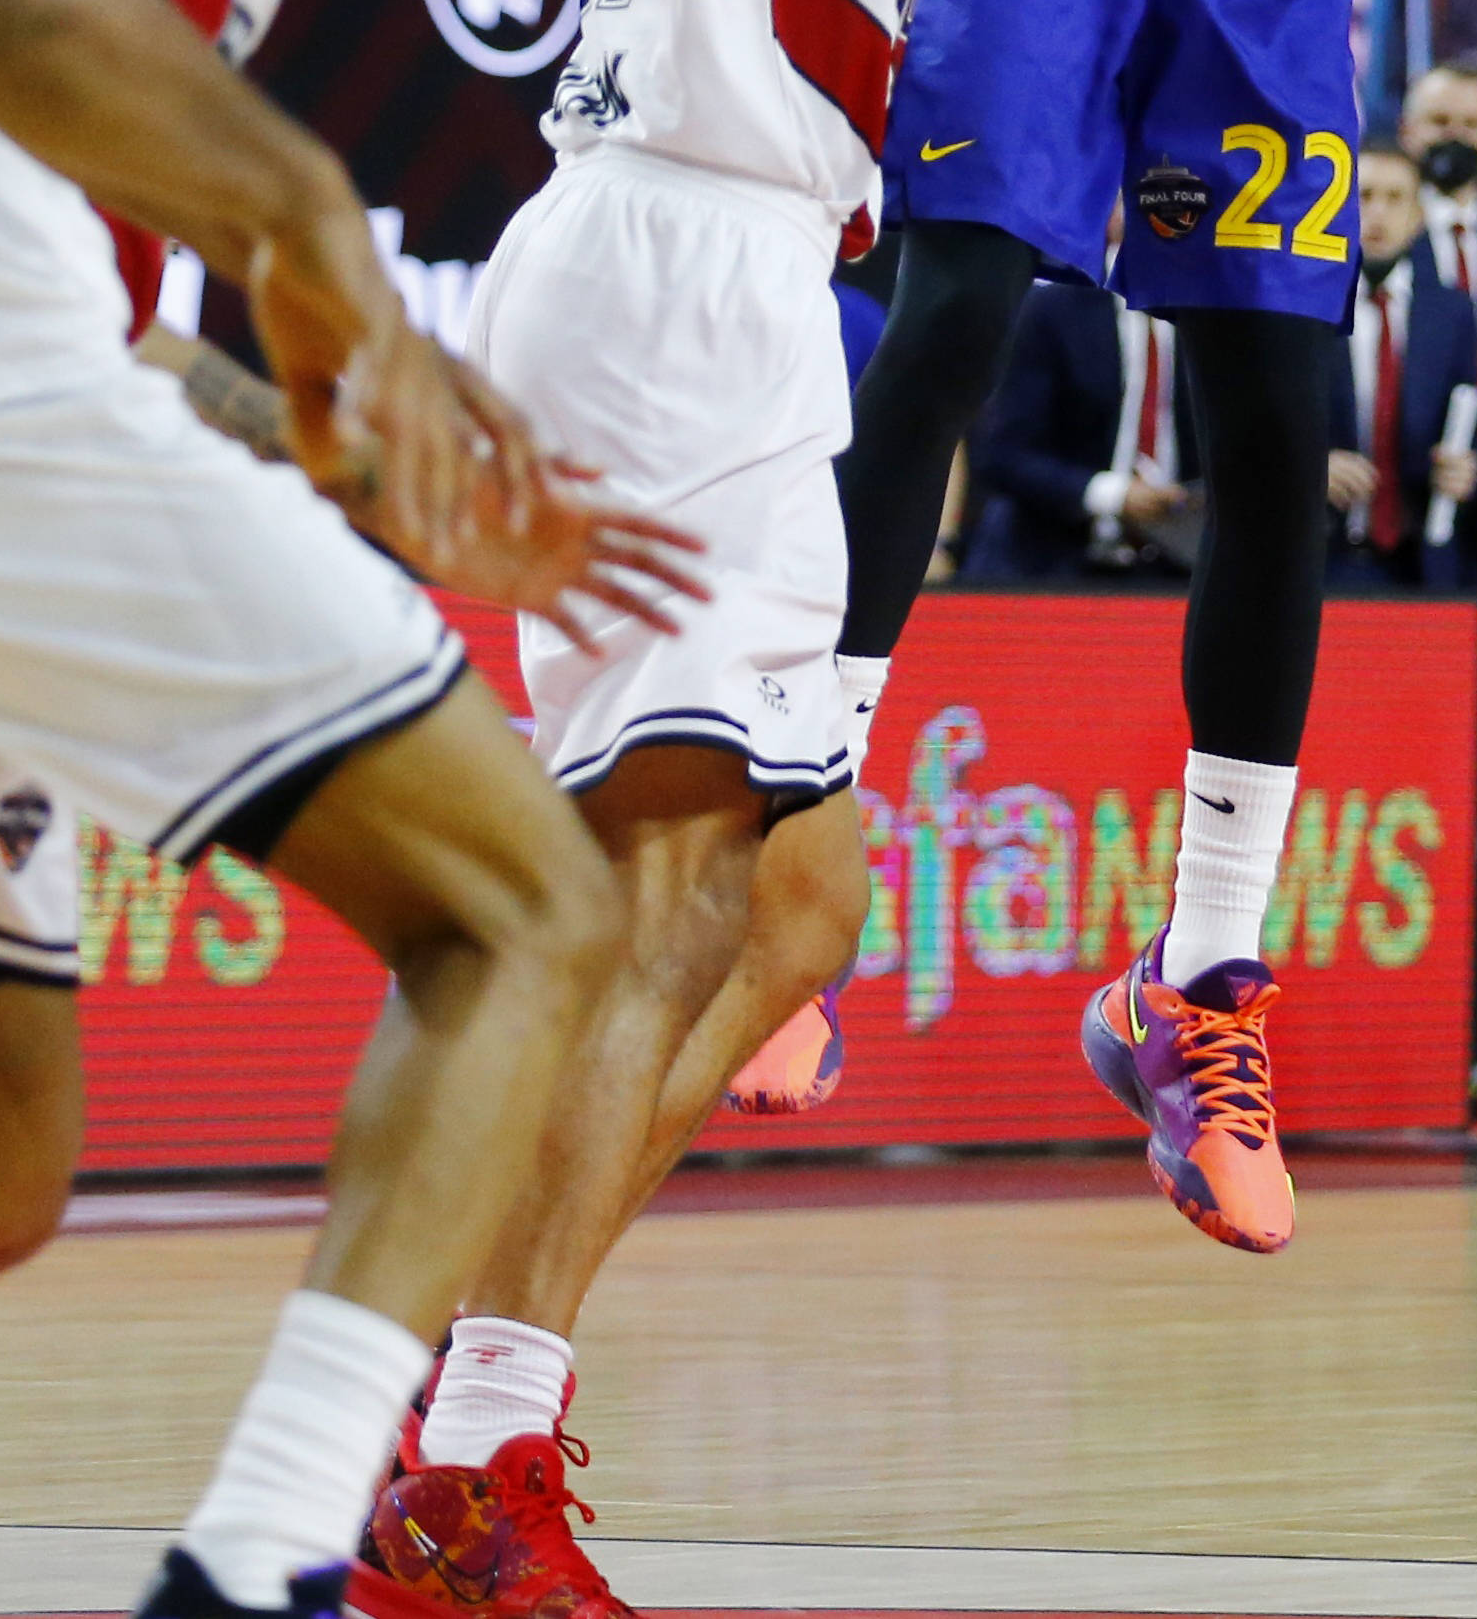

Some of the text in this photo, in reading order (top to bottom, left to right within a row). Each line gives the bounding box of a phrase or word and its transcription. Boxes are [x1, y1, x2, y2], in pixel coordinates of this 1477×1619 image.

[1139, 190, 1207, 206] FINAL FOUR
[1215, 123, 1353, 263] 22
